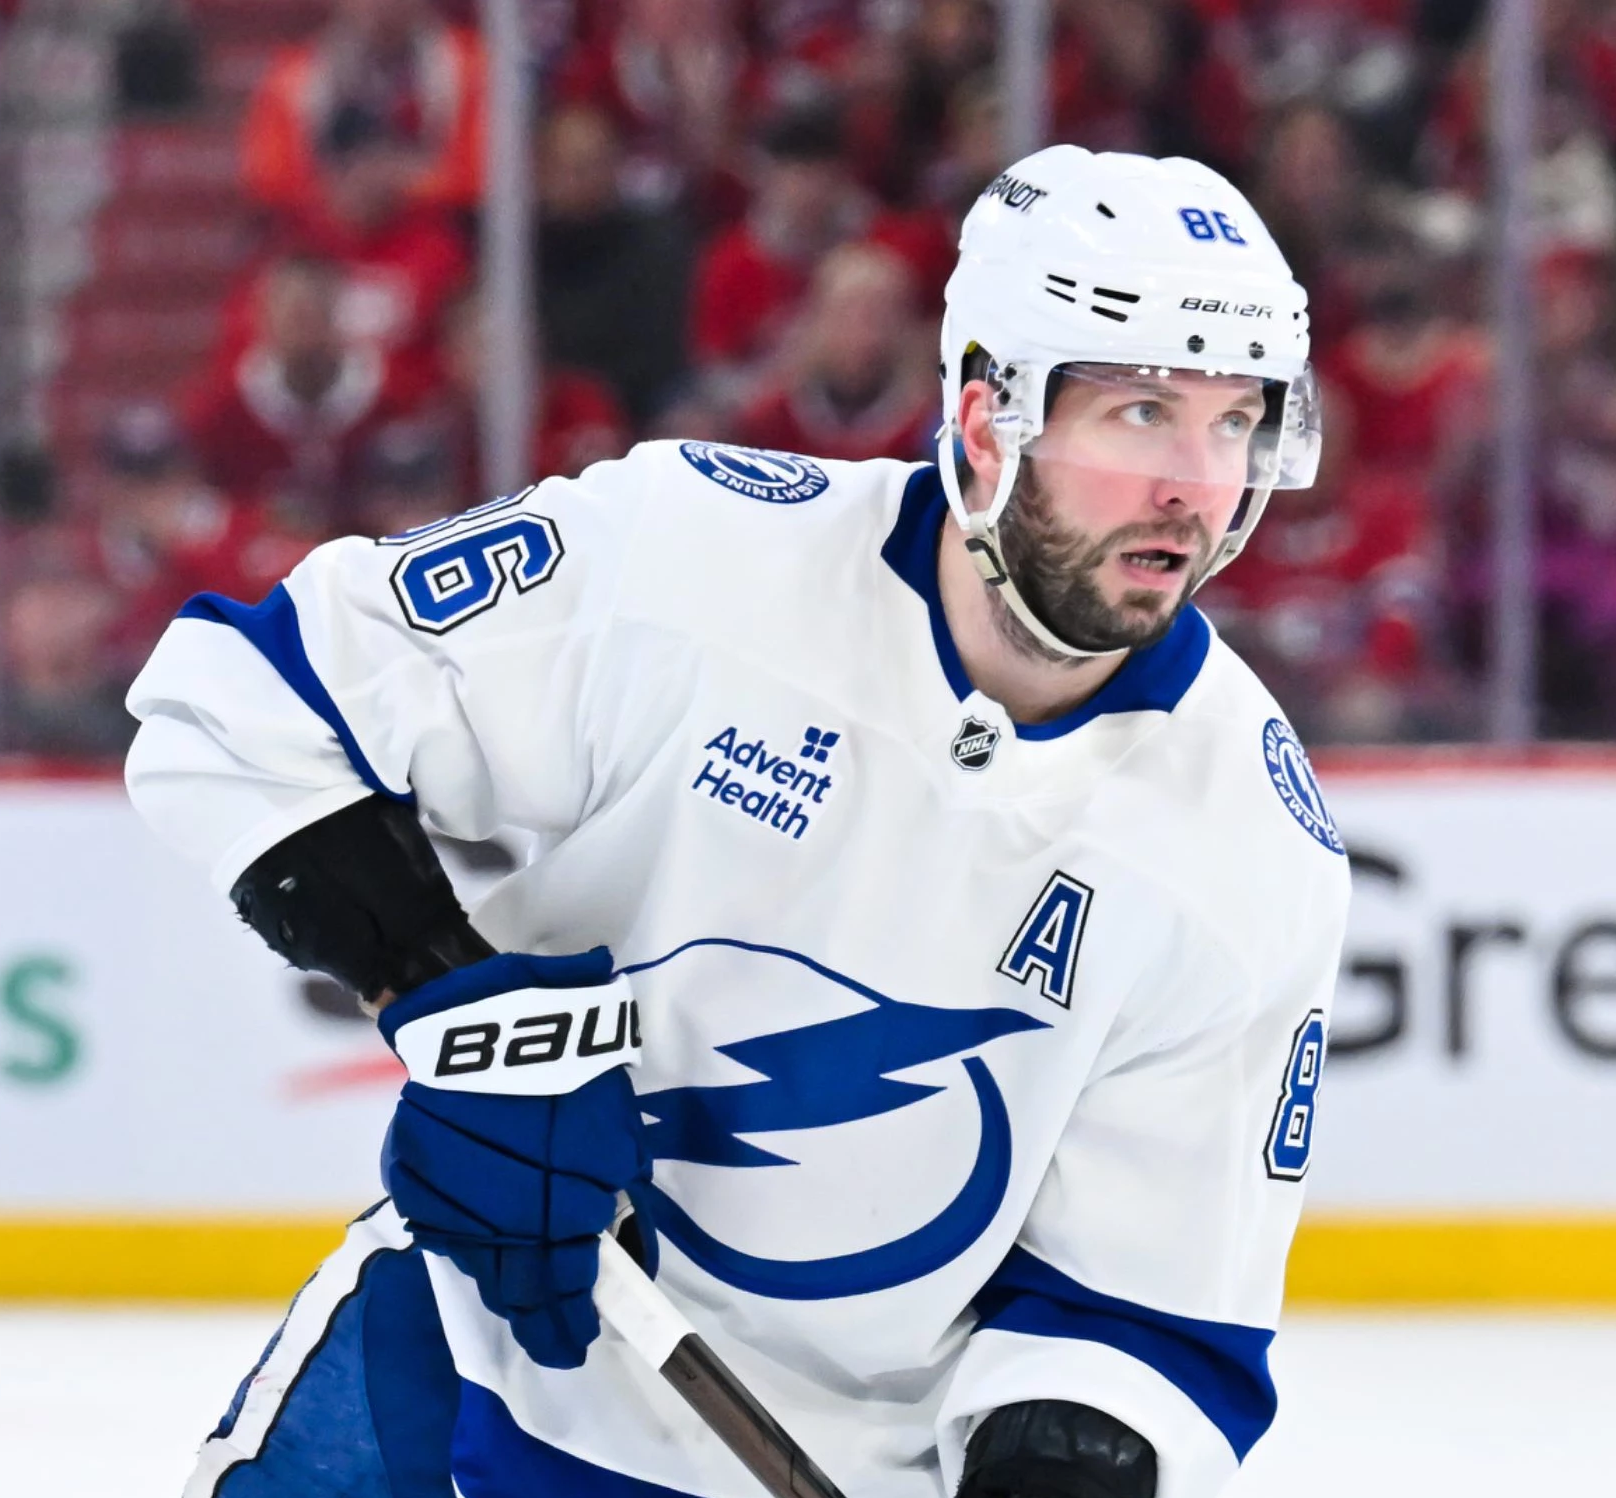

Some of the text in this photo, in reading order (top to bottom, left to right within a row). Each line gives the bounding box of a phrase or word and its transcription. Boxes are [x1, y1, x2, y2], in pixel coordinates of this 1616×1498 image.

[1178, 207, 1248, 246] 86
[377, 484, 565, 636] 6
[704, 726, 832, 804] Advent
[957, 735, 991, 756] NHL
[691, 760, 809, 840] Health
[996, 869, 1094, 1011] A
[434, 999, 643, 1078] BAU
[1262, 1008, 1326, 1182] 8
